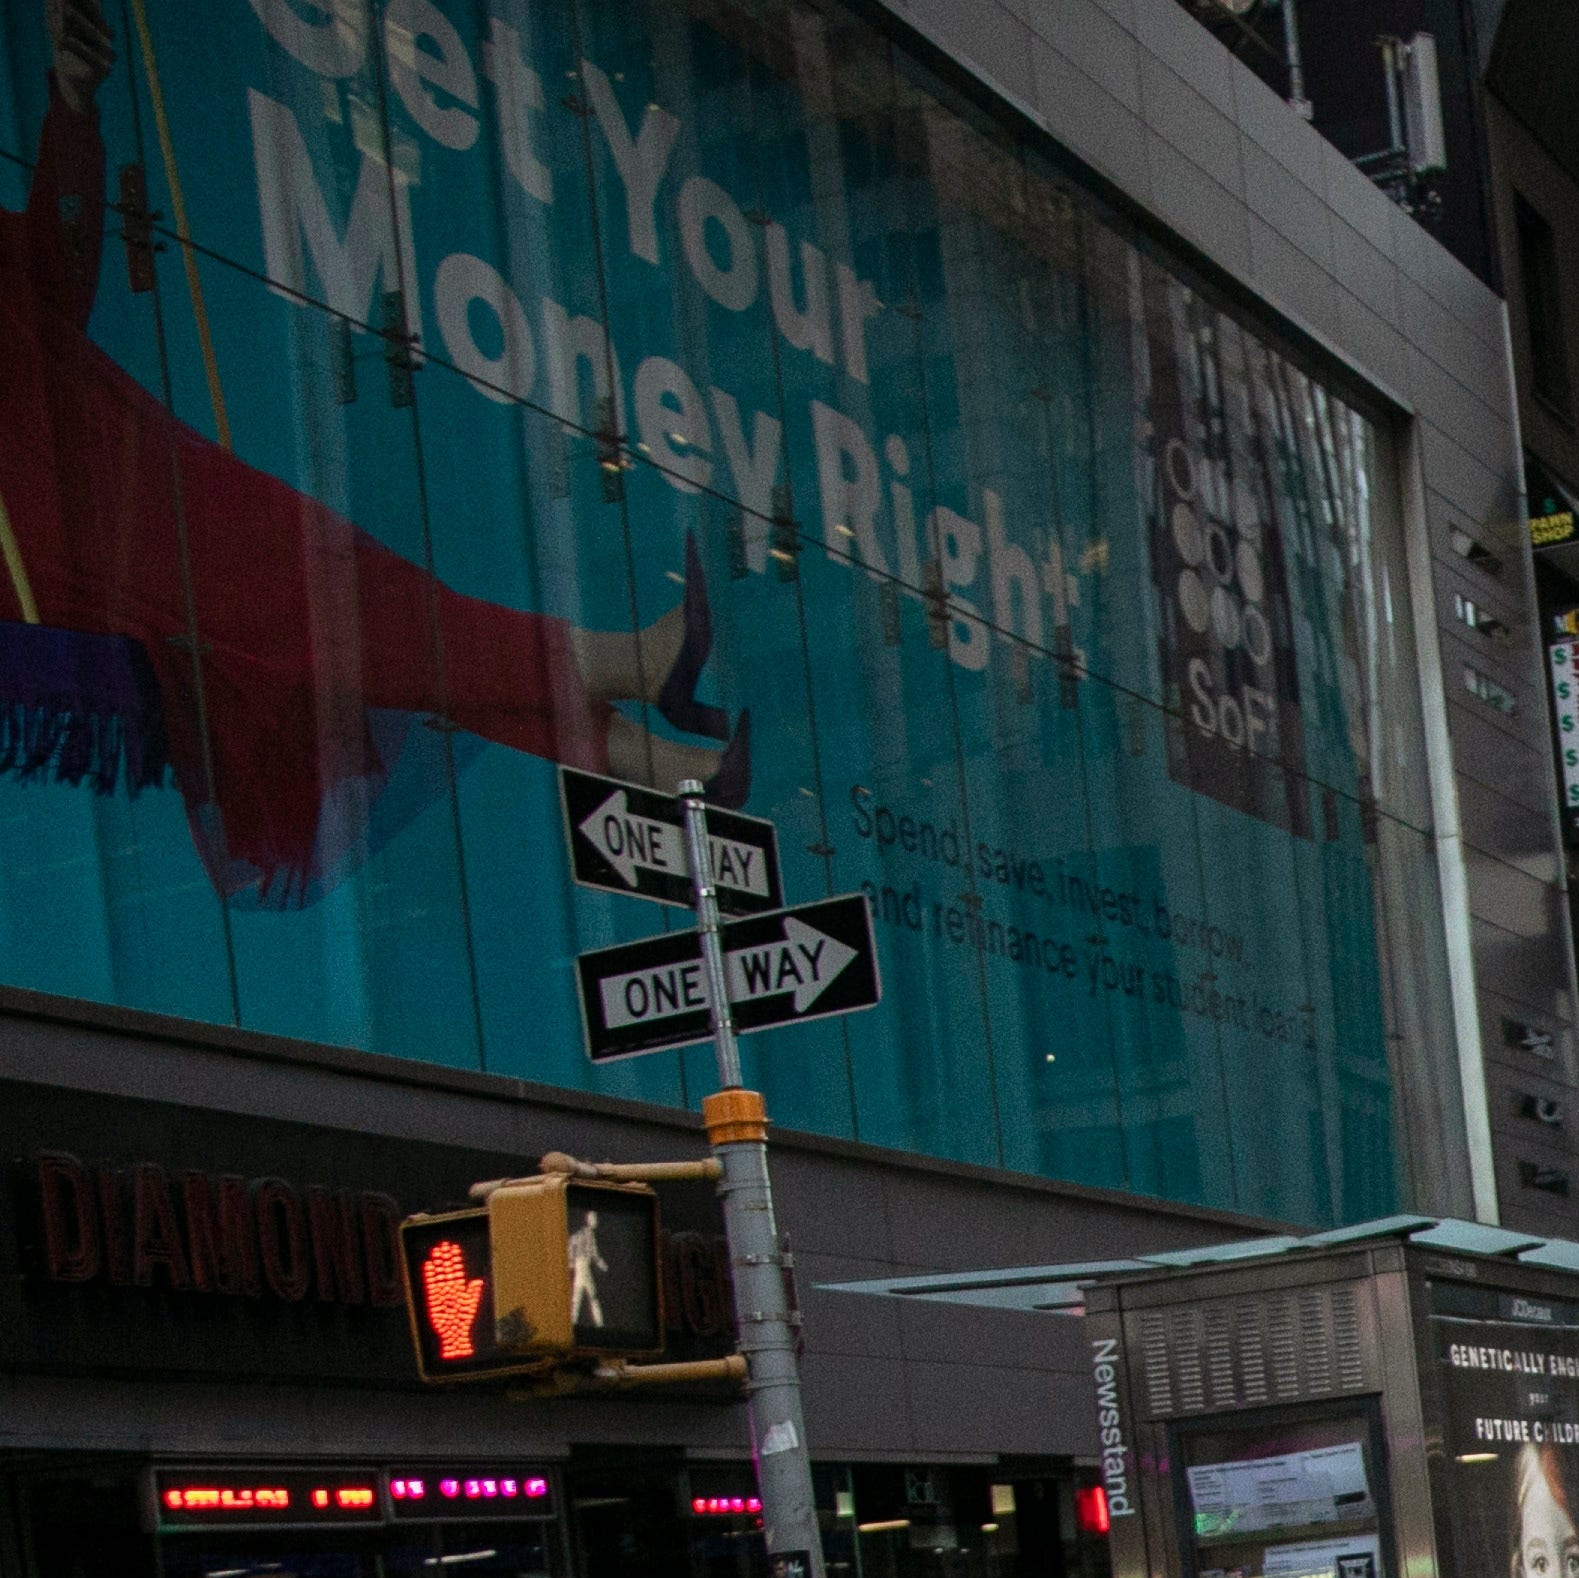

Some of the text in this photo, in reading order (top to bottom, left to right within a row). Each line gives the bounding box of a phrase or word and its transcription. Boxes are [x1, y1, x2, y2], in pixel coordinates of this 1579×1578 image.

[580, 57, 880, 384] Your
[247, 86, 1089, 683] Money Right
[604, 814, 667, 867] ONE
[977, 842, 1051, 900] save,
[624, 938, 825, 1018] ONE WAY
[1086, 945, 1145, 996] your
[1450, 1344, 1545, 1374] GENETICALLY
[1092, 1338, 1136, 1517] Newsstand
[1475, 1417, 1530, 1441] FUTURE
